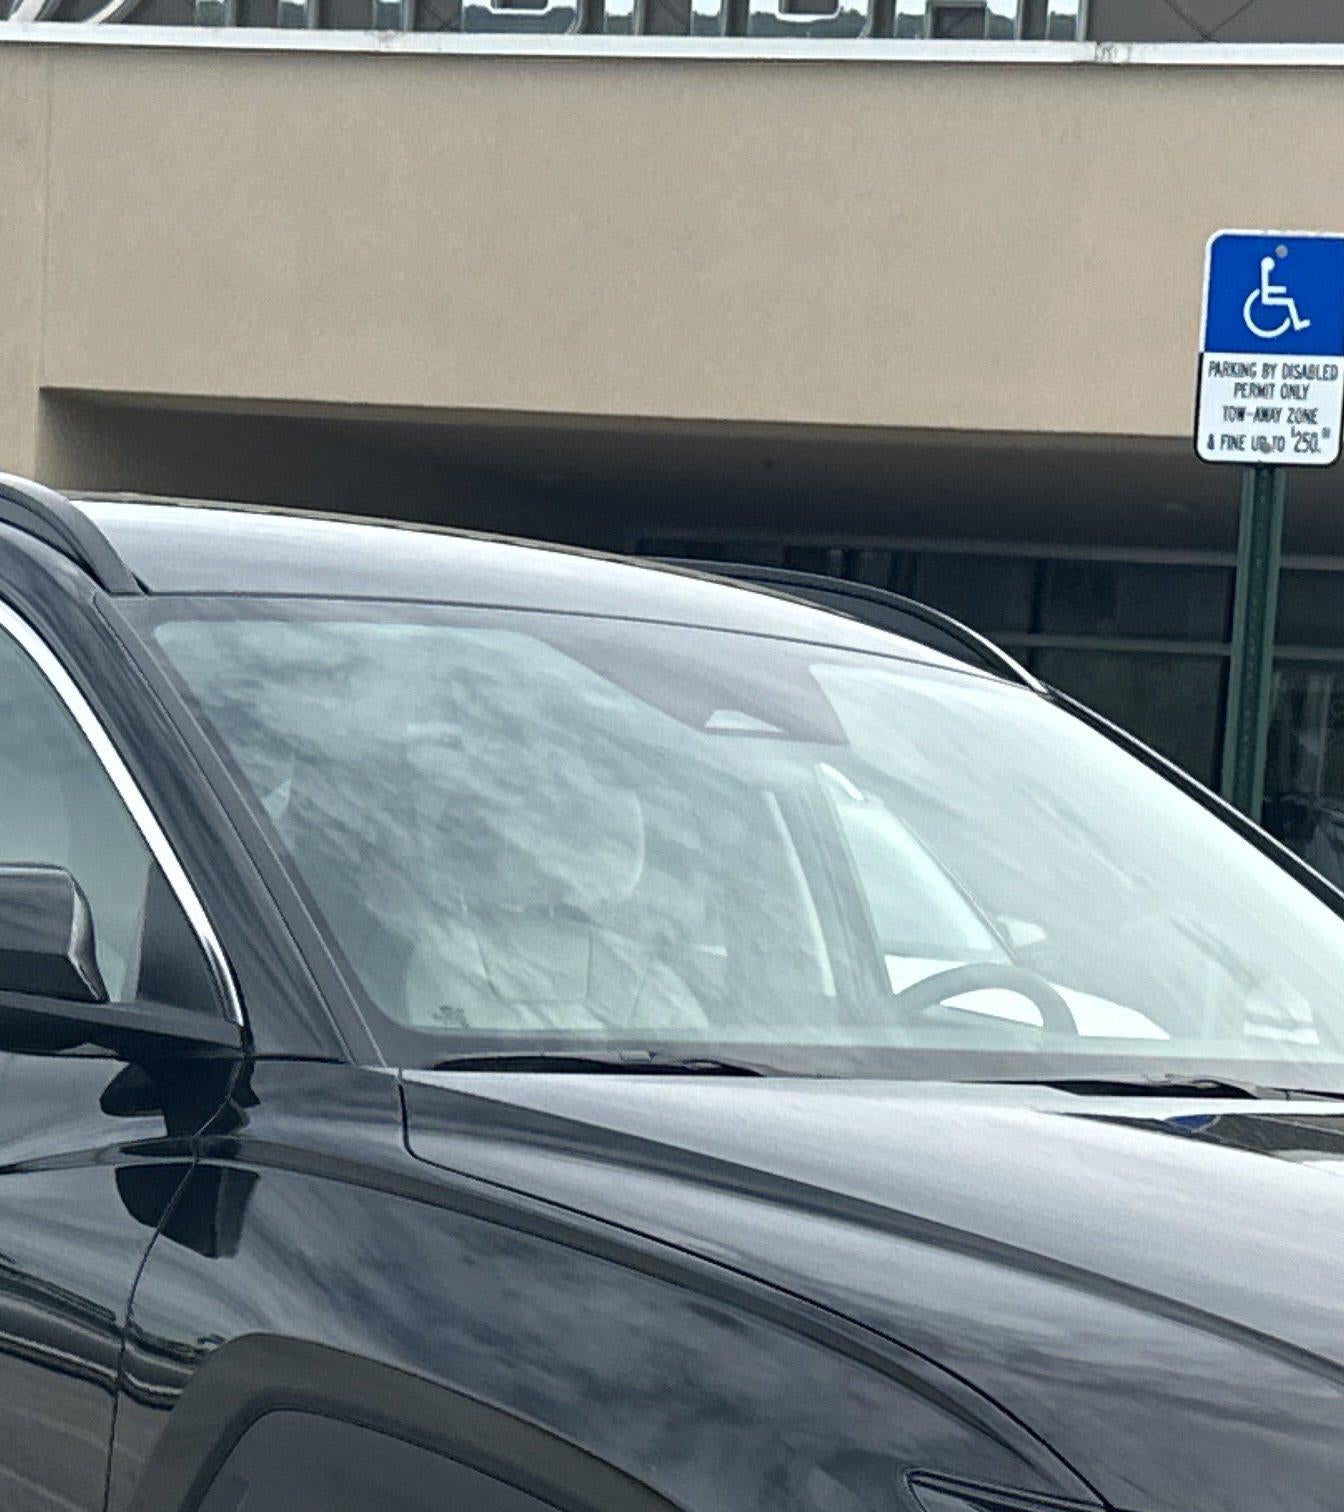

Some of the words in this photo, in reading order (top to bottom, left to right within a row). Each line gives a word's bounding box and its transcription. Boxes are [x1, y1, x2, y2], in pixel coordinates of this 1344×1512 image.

[1208, 361, 1257, 379] PARKING
[1261, 363, 1277, 380] BY
[1282, 363, 1338, 380] DISABLED
[1233, 382, 1276, 399] PERMIT
[1280, 383, 1310, 401] ONLY
[1222, 405, 1282, 423] TOW-AWAY
[1286, 407, 1318, 424] ZONE
[1207, 433, 1215, 450] &
[1220, 434, 1246, 451] FINE
